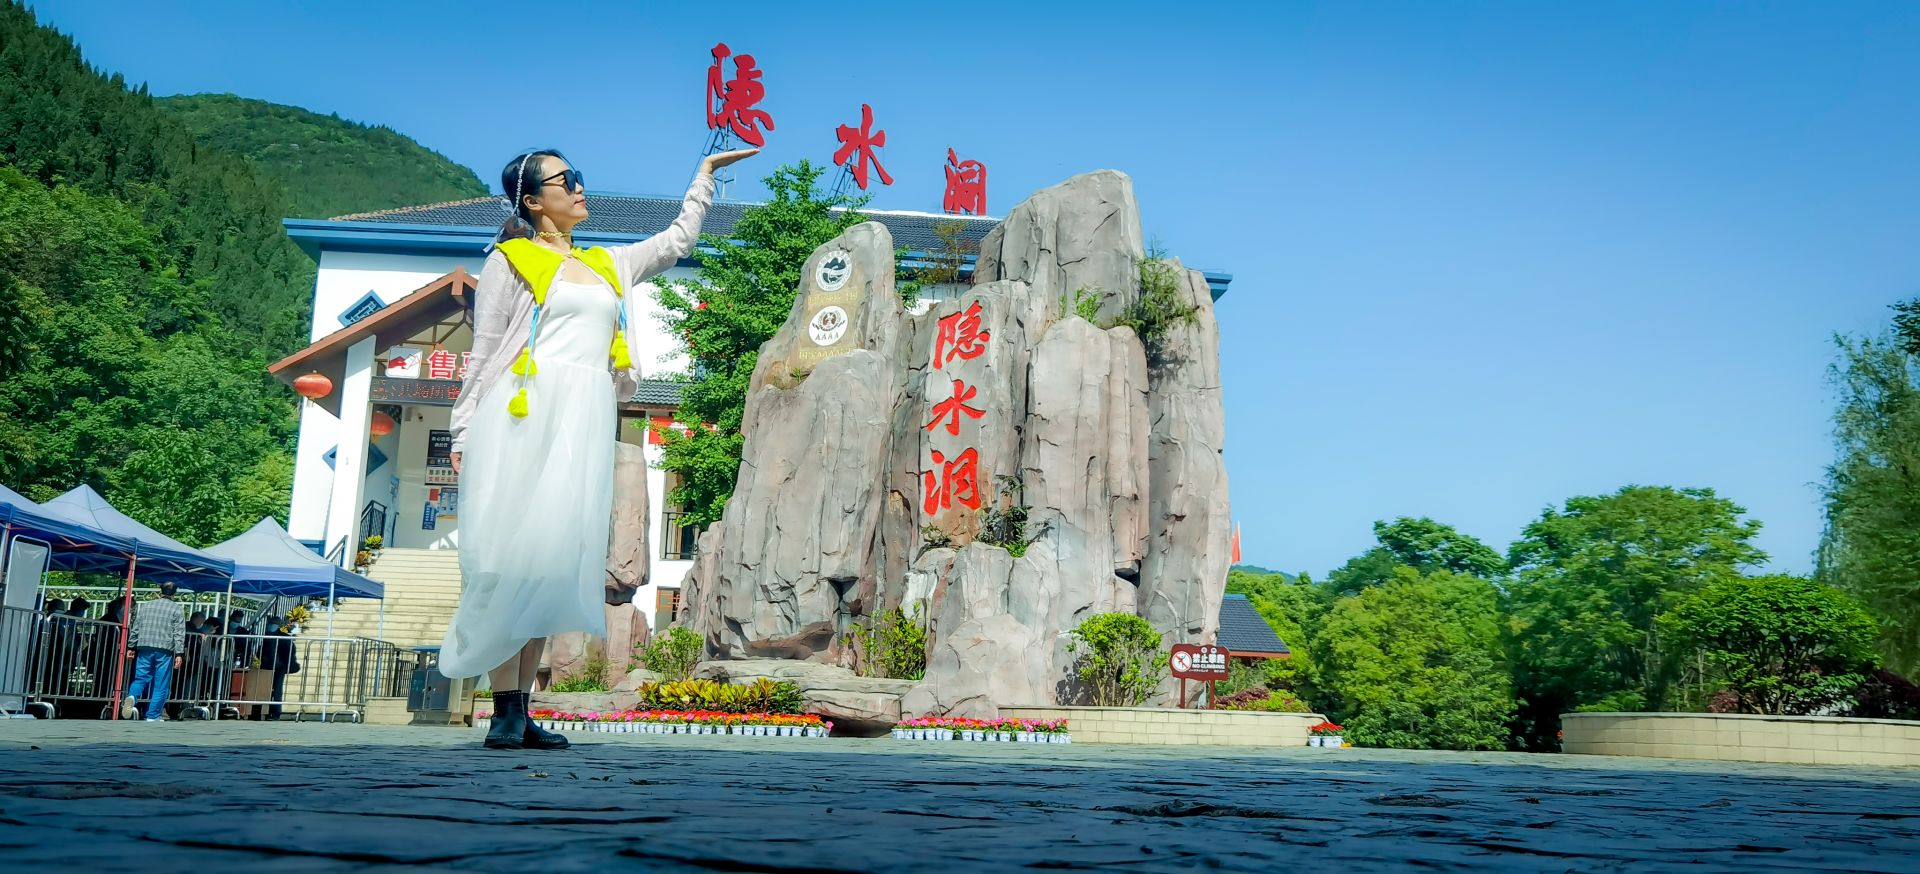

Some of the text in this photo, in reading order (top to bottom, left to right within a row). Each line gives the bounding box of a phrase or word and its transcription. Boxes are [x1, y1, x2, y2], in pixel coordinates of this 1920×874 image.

[706, 42, 987, 216] 隐水洞
[923, 300, 991, 517] 隐水洞
